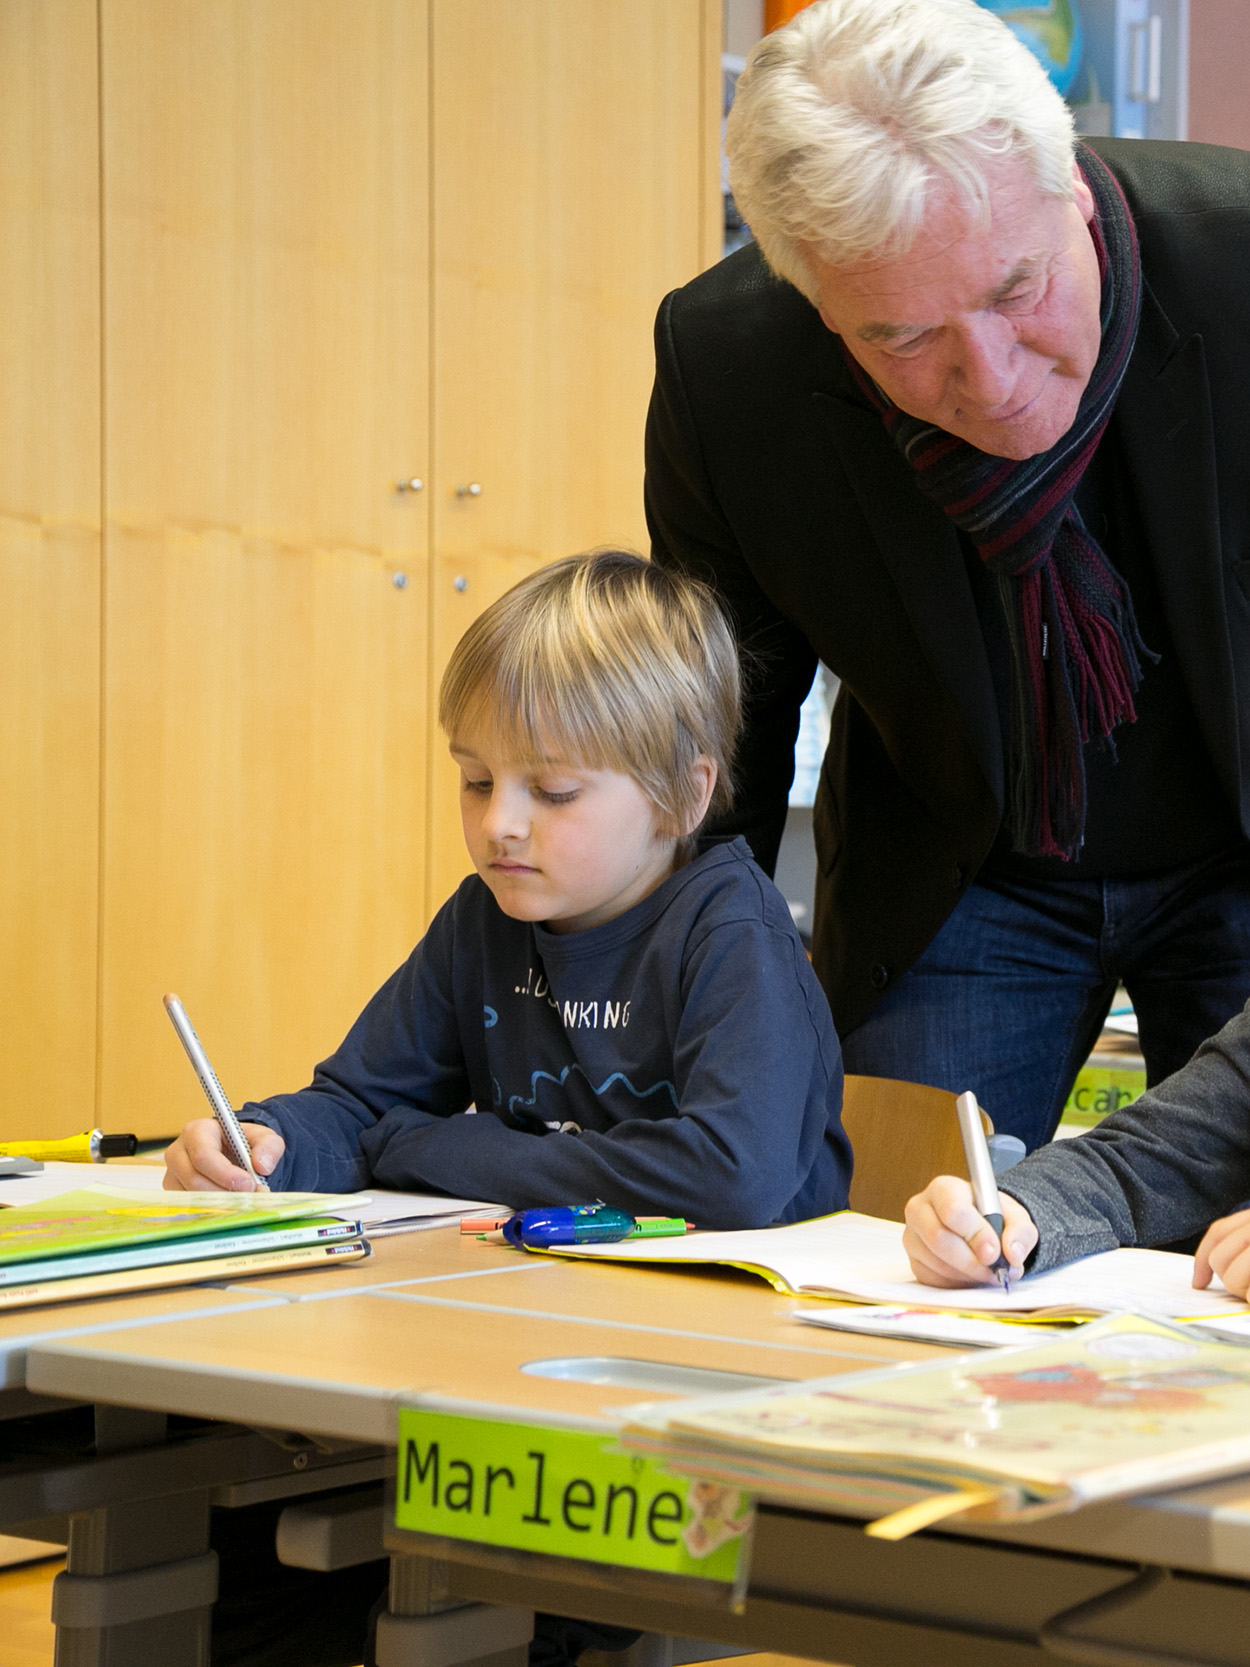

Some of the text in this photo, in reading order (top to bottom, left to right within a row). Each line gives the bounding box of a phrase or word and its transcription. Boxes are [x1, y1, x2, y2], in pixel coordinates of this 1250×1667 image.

[556, 1000, 631, 1029] NKING
[1067, 1086, 1132, 1113] car
[403, 1439, 685, 1546] Marlene
